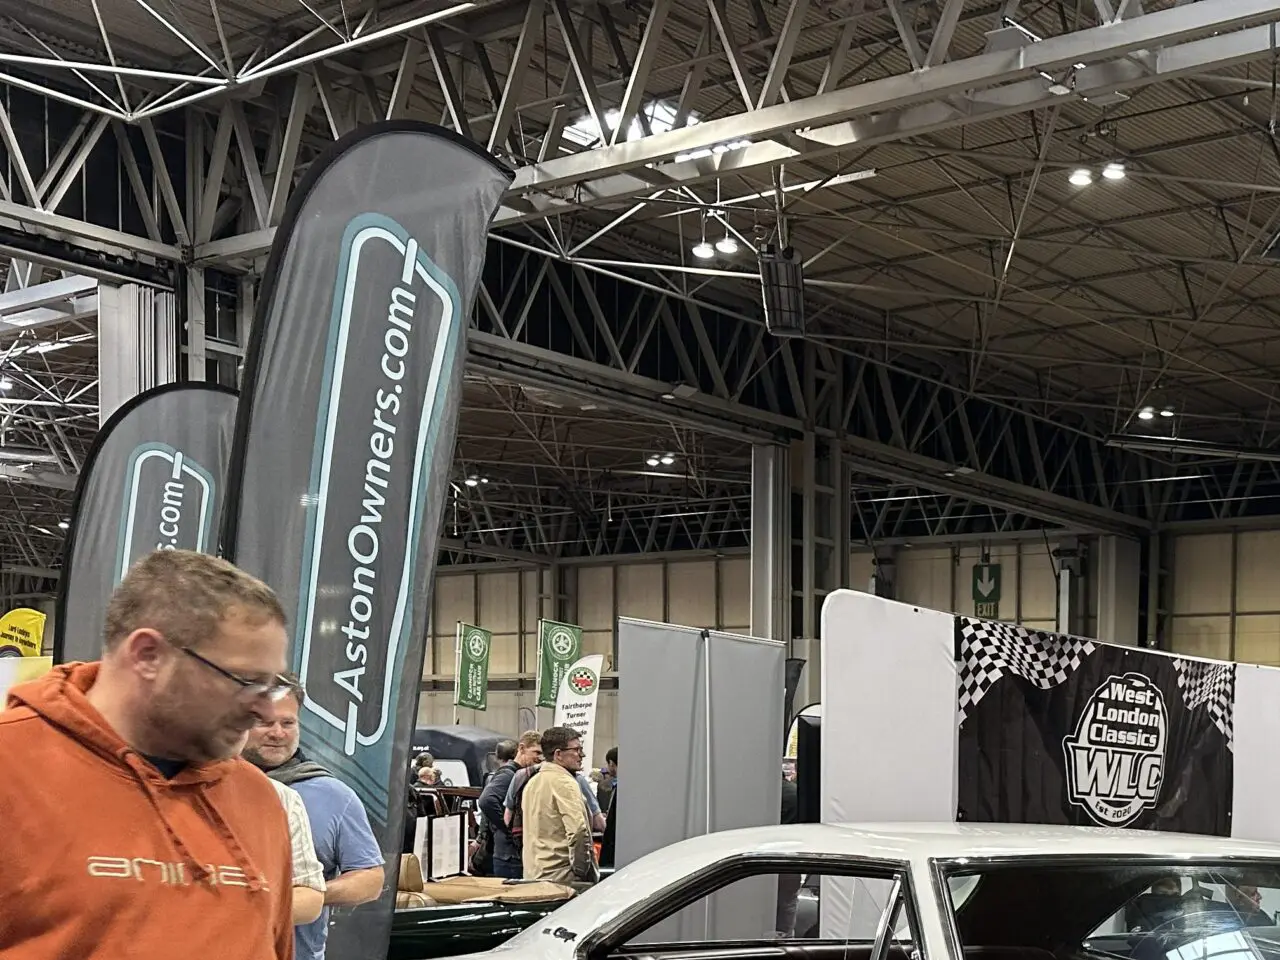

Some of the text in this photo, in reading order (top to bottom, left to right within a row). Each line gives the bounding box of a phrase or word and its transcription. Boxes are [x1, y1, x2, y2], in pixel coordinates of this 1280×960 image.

[333, 290, 417, 703] AstonOwners.com
[977, 603, 997, 617] EXIT
[1110, 682, 1155, 705] West
[561, 701, 593, 711] Fairthorpe
[566, 711, 587, 719] Turner
[1096, 702, 1160, 727] London
[1089, 723, 1158, 747] Classics
[1075, 749, 1162, 797] WLC
[1095, 800, 1132, 818] Est 2020
